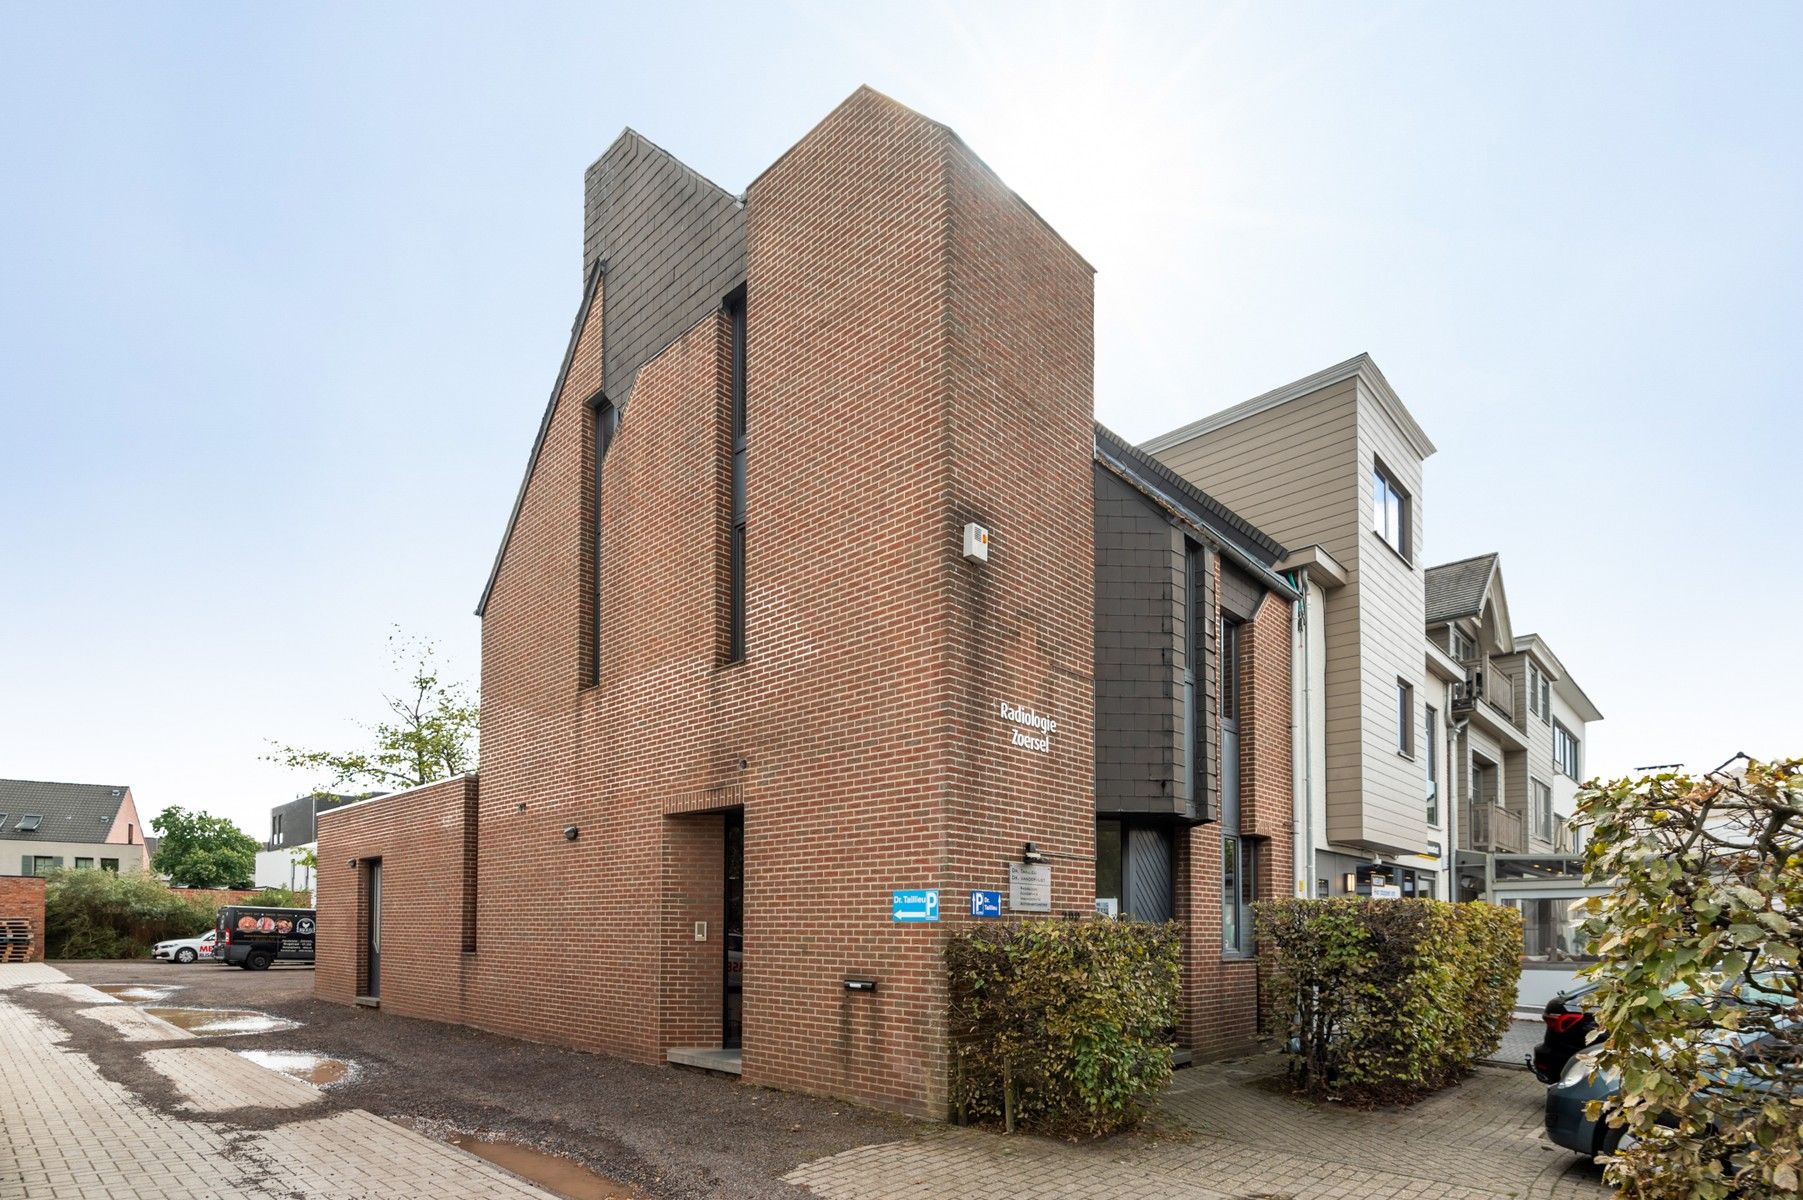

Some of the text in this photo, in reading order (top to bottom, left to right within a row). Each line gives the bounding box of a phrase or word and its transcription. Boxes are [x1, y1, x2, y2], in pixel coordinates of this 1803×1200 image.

[1001, 702, 1057, 734] Radiologie
[1011, 729, 1049, 753] Zoersel
[893, 895, 903, 904] Dr.
[926, 892, 938, 916] P
[975, 892, 984, 912] P
